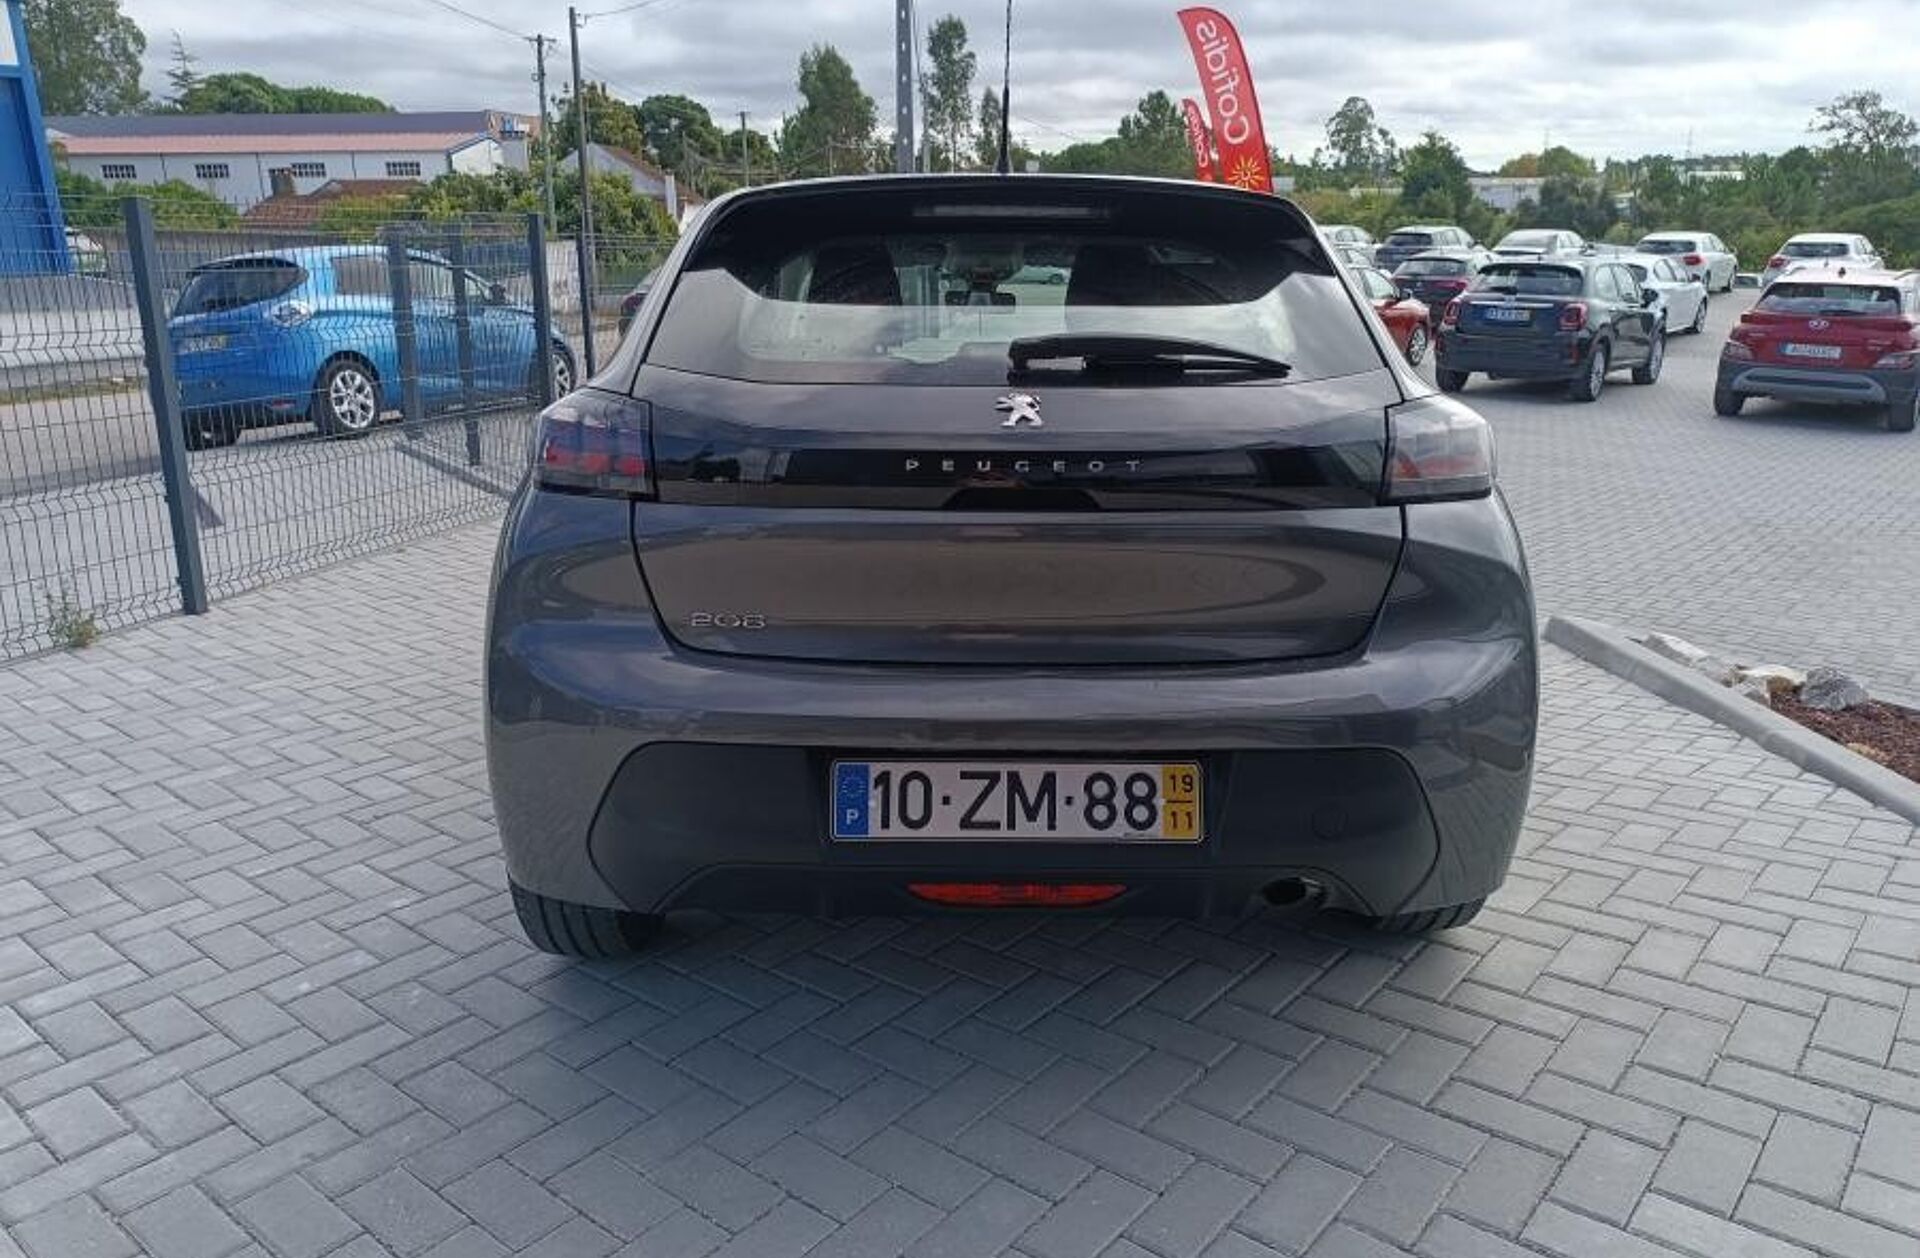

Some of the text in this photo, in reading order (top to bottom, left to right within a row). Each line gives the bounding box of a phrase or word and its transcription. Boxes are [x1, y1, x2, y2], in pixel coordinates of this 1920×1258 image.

[905, 458, 1141, 473] PEUGEOT
[690, 611, 767, 630] 208
[1169, 774, 1194, 794] 19
[846, 809, 860, 825] P
[1170, 811, 1194, 831] 11
